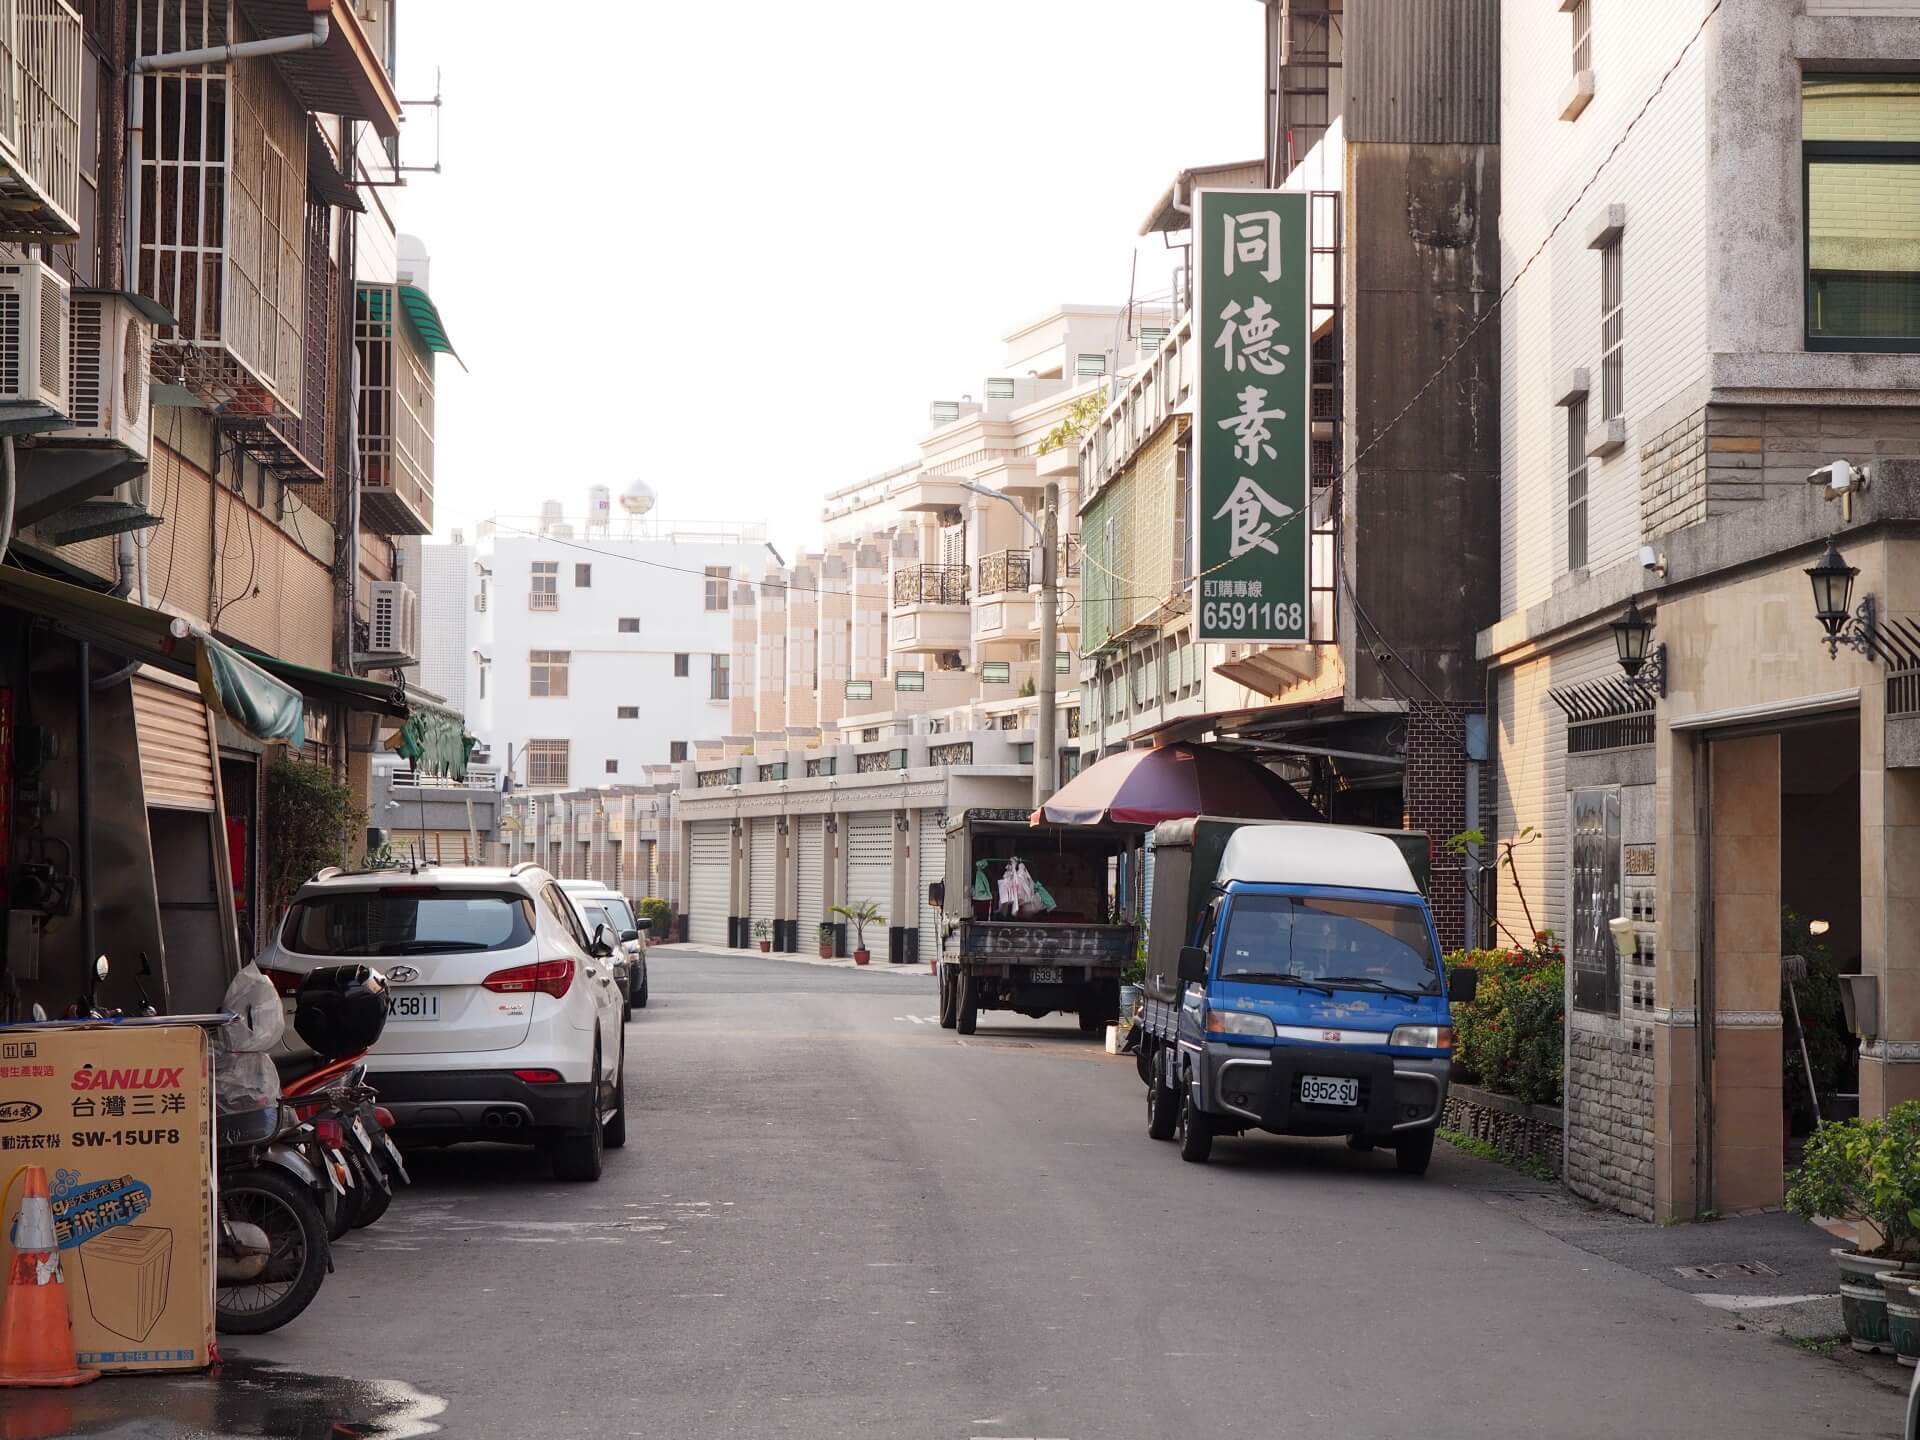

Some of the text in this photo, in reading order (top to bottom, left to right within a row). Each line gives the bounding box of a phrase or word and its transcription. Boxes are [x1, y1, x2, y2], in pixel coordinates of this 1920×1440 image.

[1212, 210, 1294, 555] 同德素食
[1203, 580, 1263, 598] 訂購專線
[1203, 602, 1302, 630] 6591168
[71, 1067, 184, 1090] SANLUX
[71, 1093, 186, 1118] 台灣三洋
[2, 1133, 61, 1150] 動洗衣機
[71, 1129, 180, 1148] SW-15UF8
